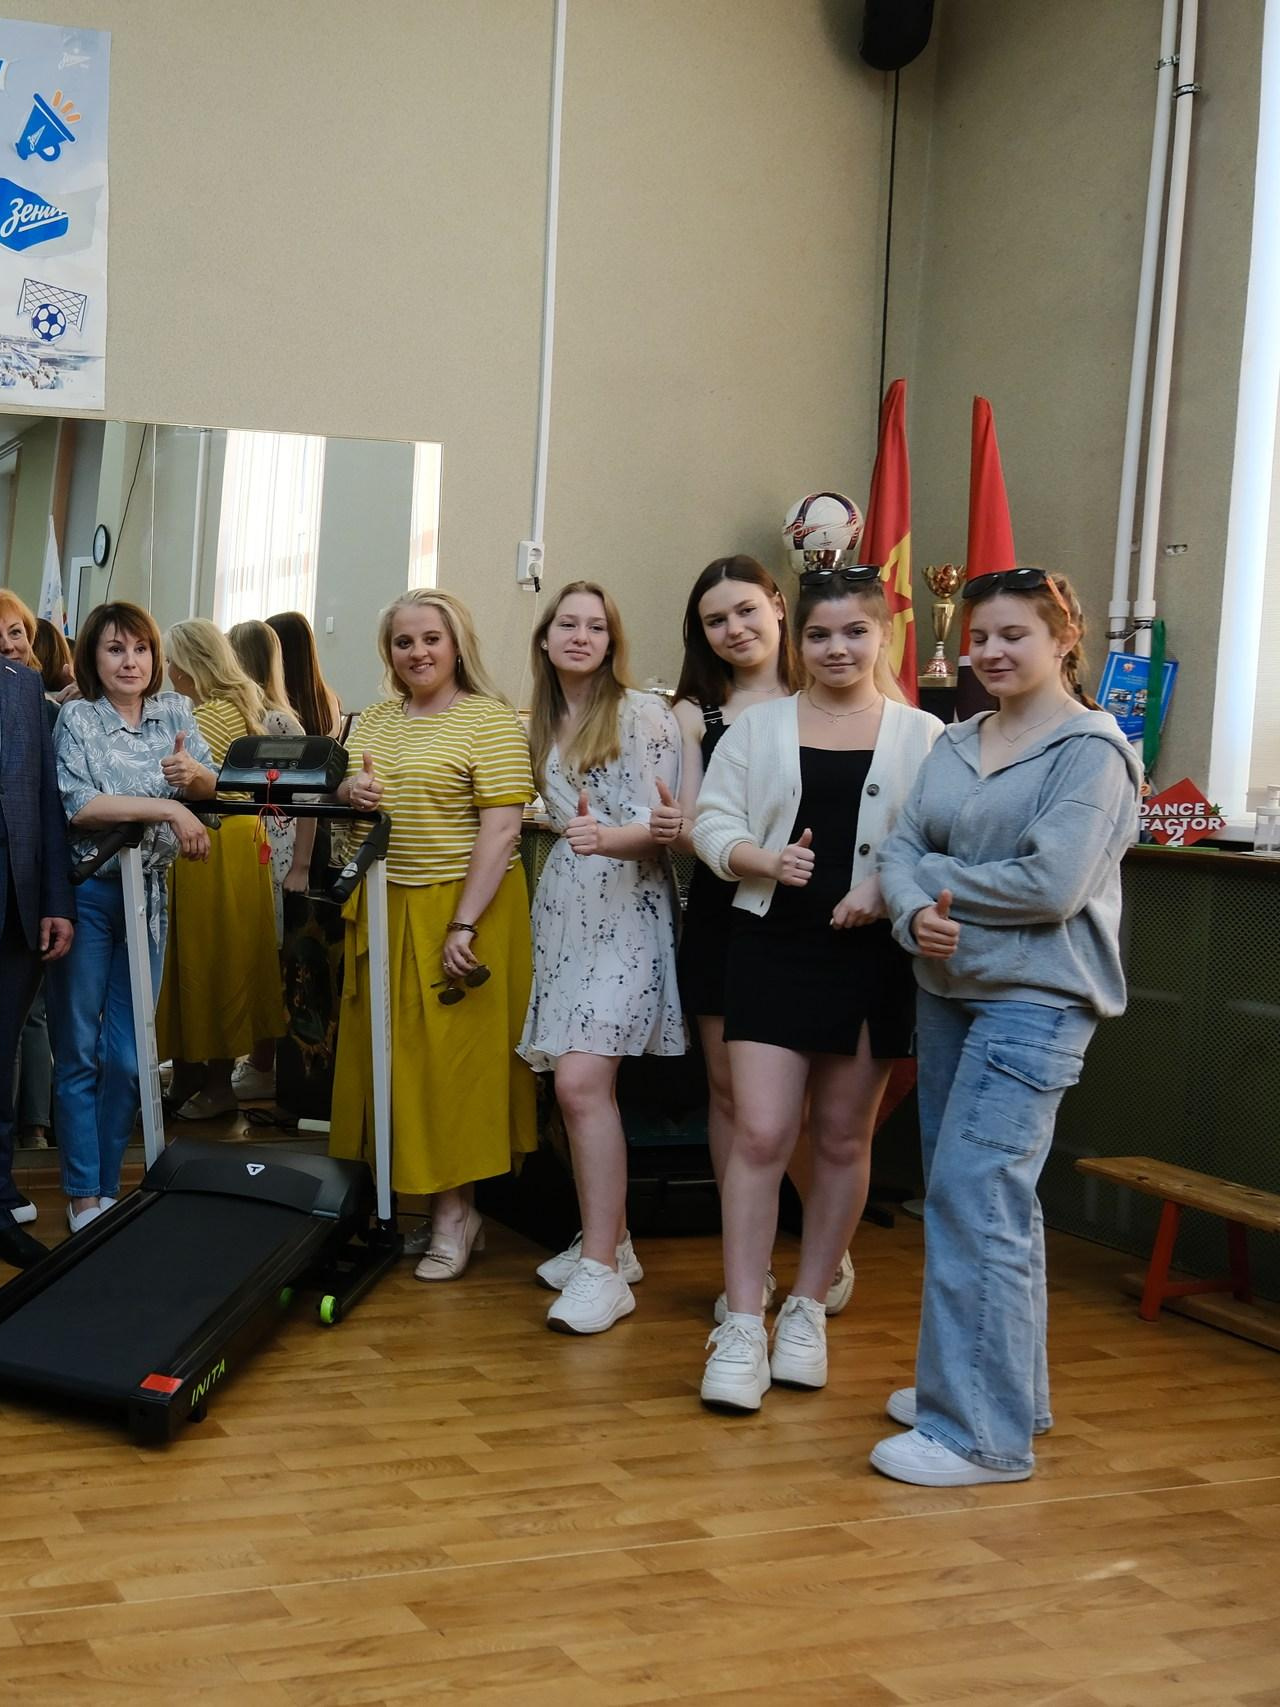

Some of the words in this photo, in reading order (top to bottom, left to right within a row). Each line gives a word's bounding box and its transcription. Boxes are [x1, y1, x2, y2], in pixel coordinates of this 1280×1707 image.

[1139, 802, 1206, 817] DANCE
[1140, 817, 1222, 832] FACTOR
[1166, 825, 1185, 847] 2
[190, 1358, 226, 1407] INITA
